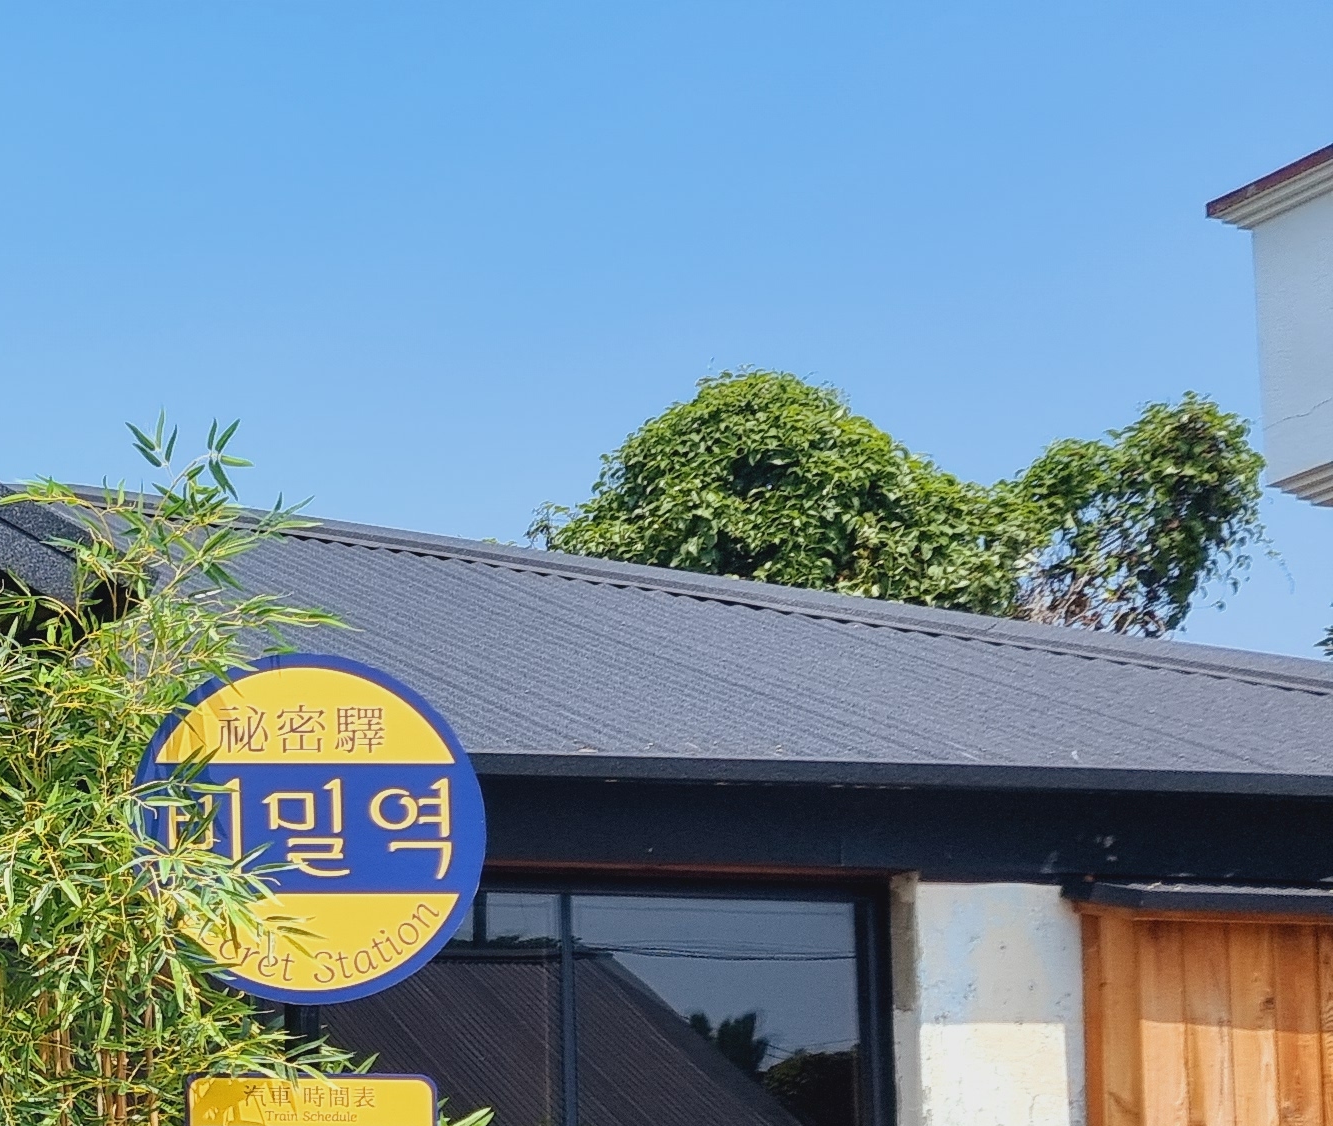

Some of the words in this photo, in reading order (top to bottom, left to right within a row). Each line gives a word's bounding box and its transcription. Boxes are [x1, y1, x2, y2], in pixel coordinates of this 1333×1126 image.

[312, 901, 440, 983] Station
[265, 1110, 298, 1122] Train
[302, 1110, 358, 1122] Schedule
